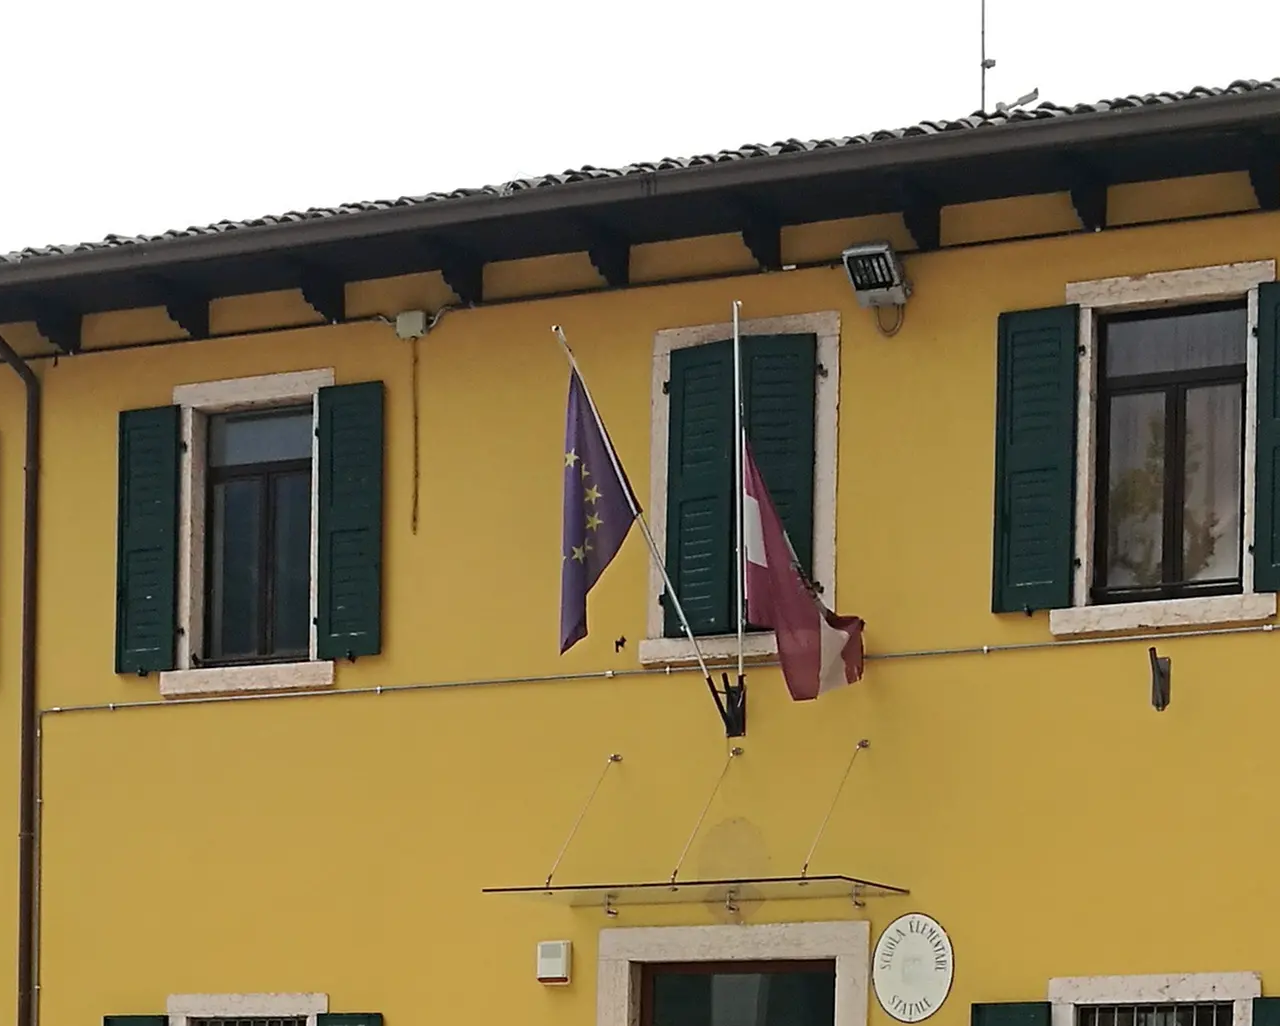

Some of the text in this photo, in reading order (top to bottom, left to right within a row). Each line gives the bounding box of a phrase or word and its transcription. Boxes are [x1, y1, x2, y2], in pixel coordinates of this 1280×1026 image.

[880, 919, 948, 972] SCUOLA ELEMENTARE
[888, 994, 933, 1016] STATALE
